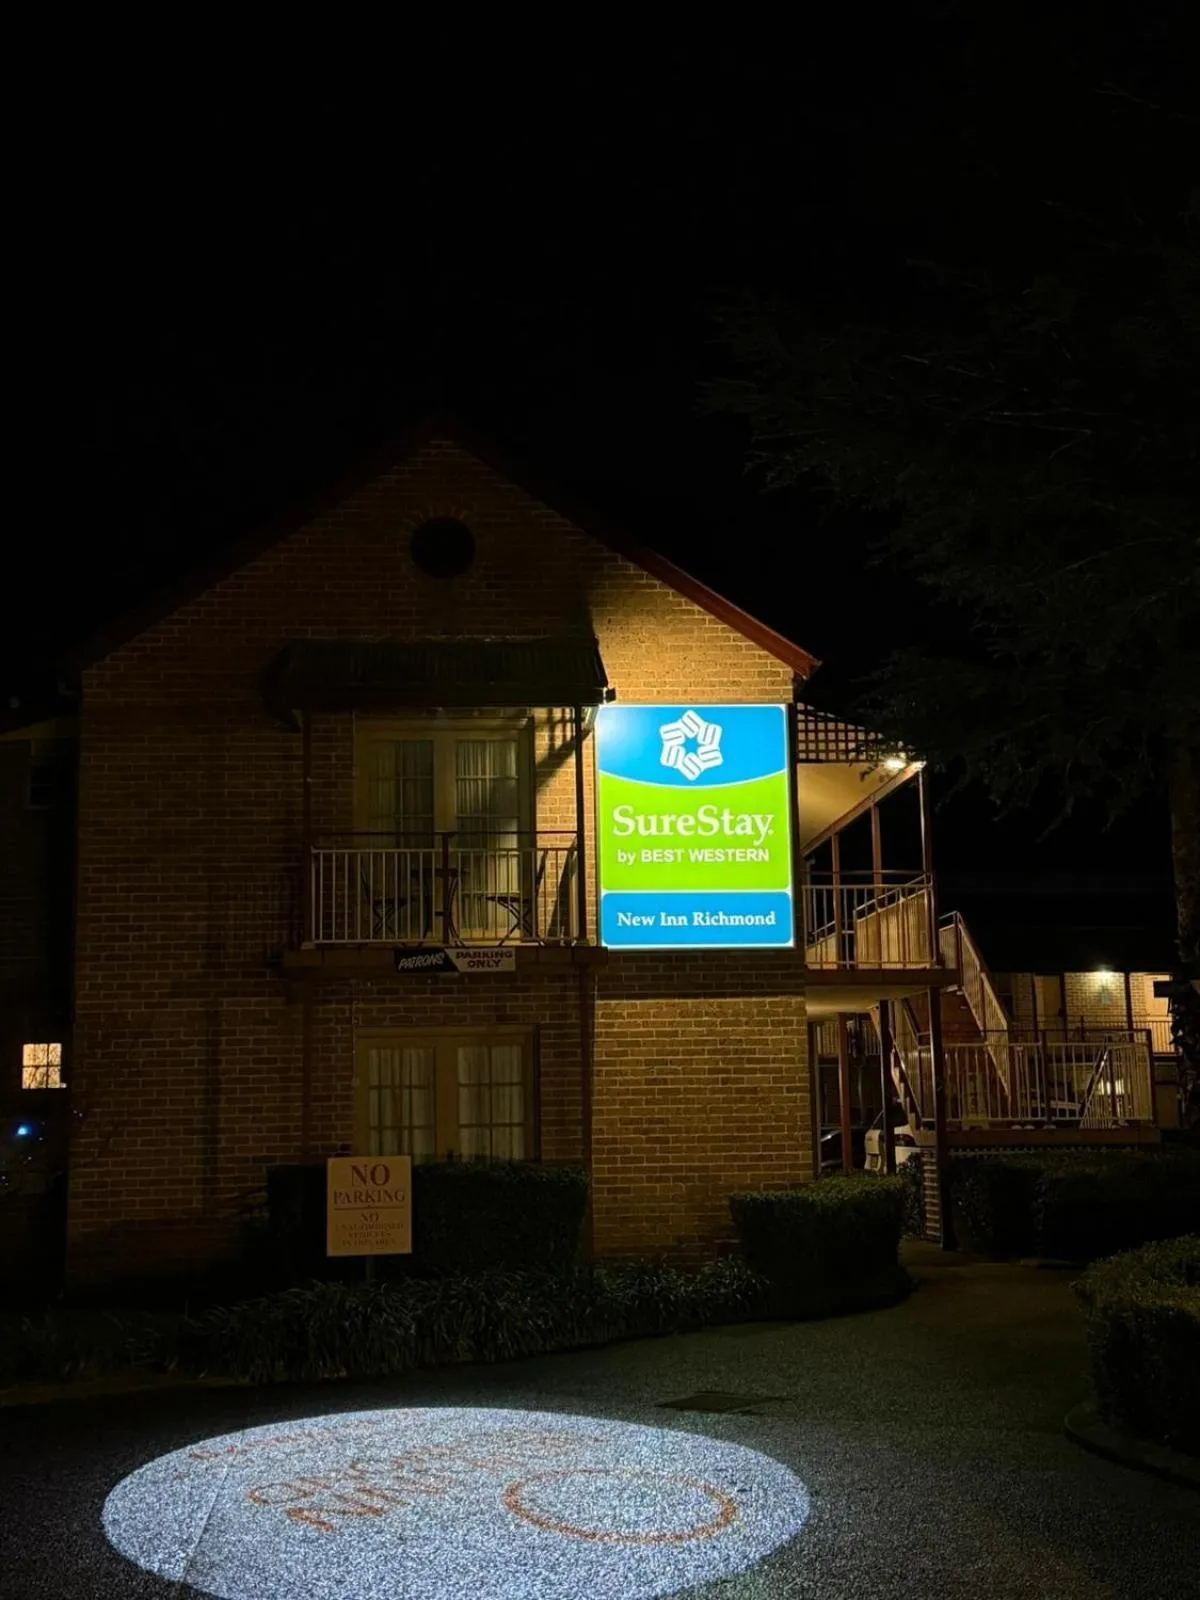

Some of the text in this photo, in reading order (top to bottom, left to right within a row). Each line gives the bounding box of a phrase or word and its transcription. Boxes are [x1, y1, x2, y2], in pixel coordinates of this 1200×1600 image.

[617, 848, 769, 866] by BEST WESTERN
[617, 911, 776, 927] New Inn Richmond
[456, 951, 513, 959] PARKING
[467, 960, 502, 969] ONLY
[350, 1163, 390, 1187] NO
[333, 1188, 405, 1205] PARKING
[360, 1212, 379, 1222] NO
